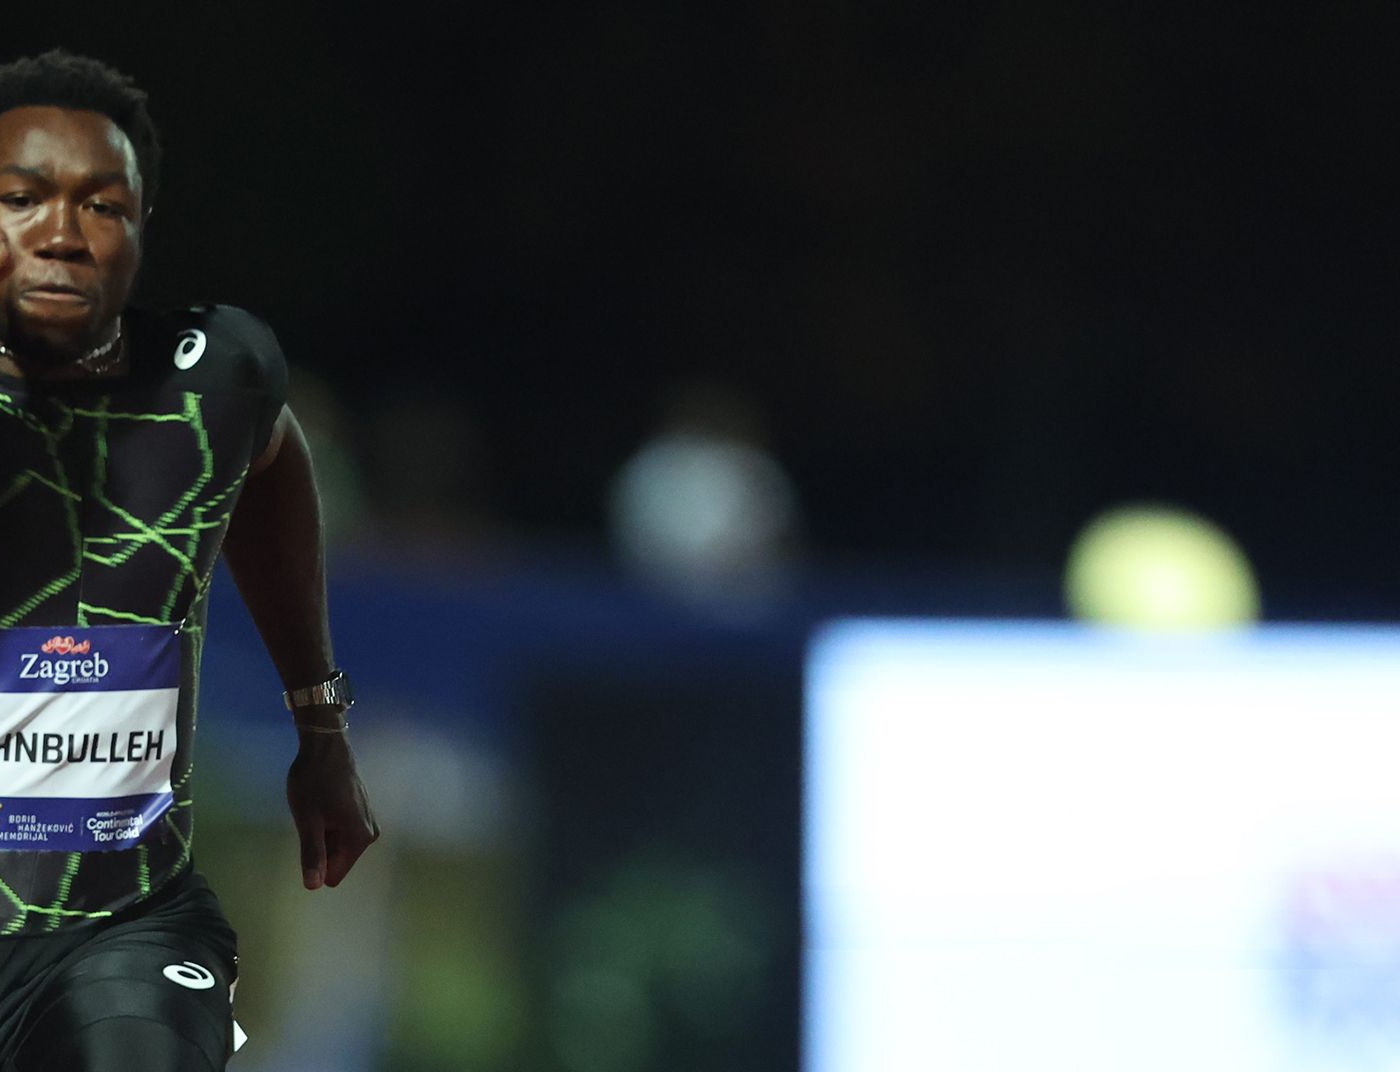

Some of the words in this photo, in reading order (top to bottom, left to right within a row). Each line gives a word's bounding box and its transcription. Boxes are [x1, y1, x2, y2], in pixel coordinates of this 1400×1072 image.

[19, 652, 109, 684] Zagreb
[8, 814, 37, 824] BORIS
[86, 814, 144, 830] Continental
[92, 830, 114, 842] Tour
[115, 827, 140, 840] Gold
